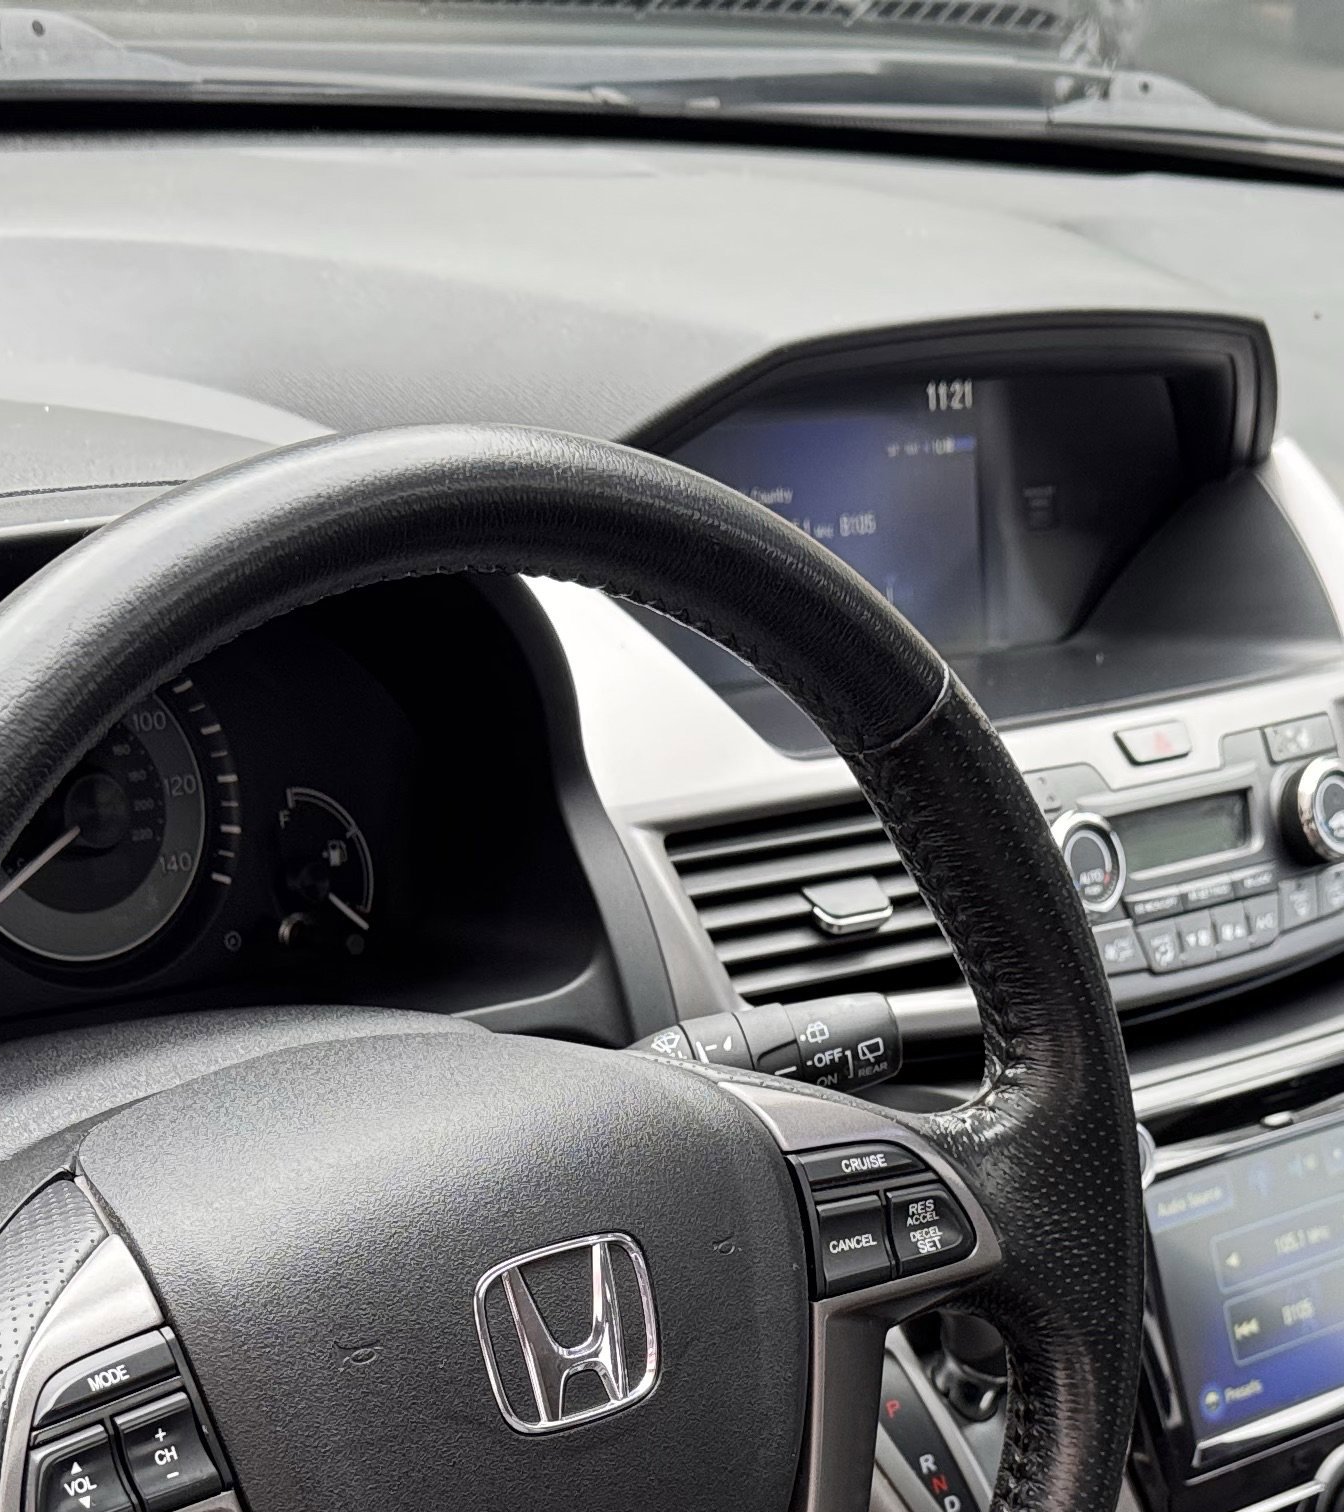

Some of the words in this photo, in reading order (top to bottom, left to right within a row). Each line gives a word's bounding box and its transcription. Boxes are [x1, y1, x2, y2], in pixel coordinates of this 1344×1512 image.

[132, 710, 167, 733] 100
[163, 773, 197, 798] 120
[278, 809, 291, 829] F
[159, 852, 192, 875] 140
[813, 1047, 844, 1068] OFF
[857, 1060, 888, 1078] REAR
[841, 1153, 888, 1174] CRUISE
[906, 1209, 940, 1227] ACCEL
[908, 1199, 935, 1216] RES
[829, 1233, 878, 1255] CANCEL
[909, 1225, 943, 1243] DECEL
[917, 1236, 942, 1255] SET
[87, 1364, 131, 1392] MODE
[885, 1399, 901, 1418] P
[154, 1444, 179, 1467] CH
[918, 1453, 938, 1475] R
[63, 1475, 98, 1497] VOL
[931, 1473, 948, 1494] N
